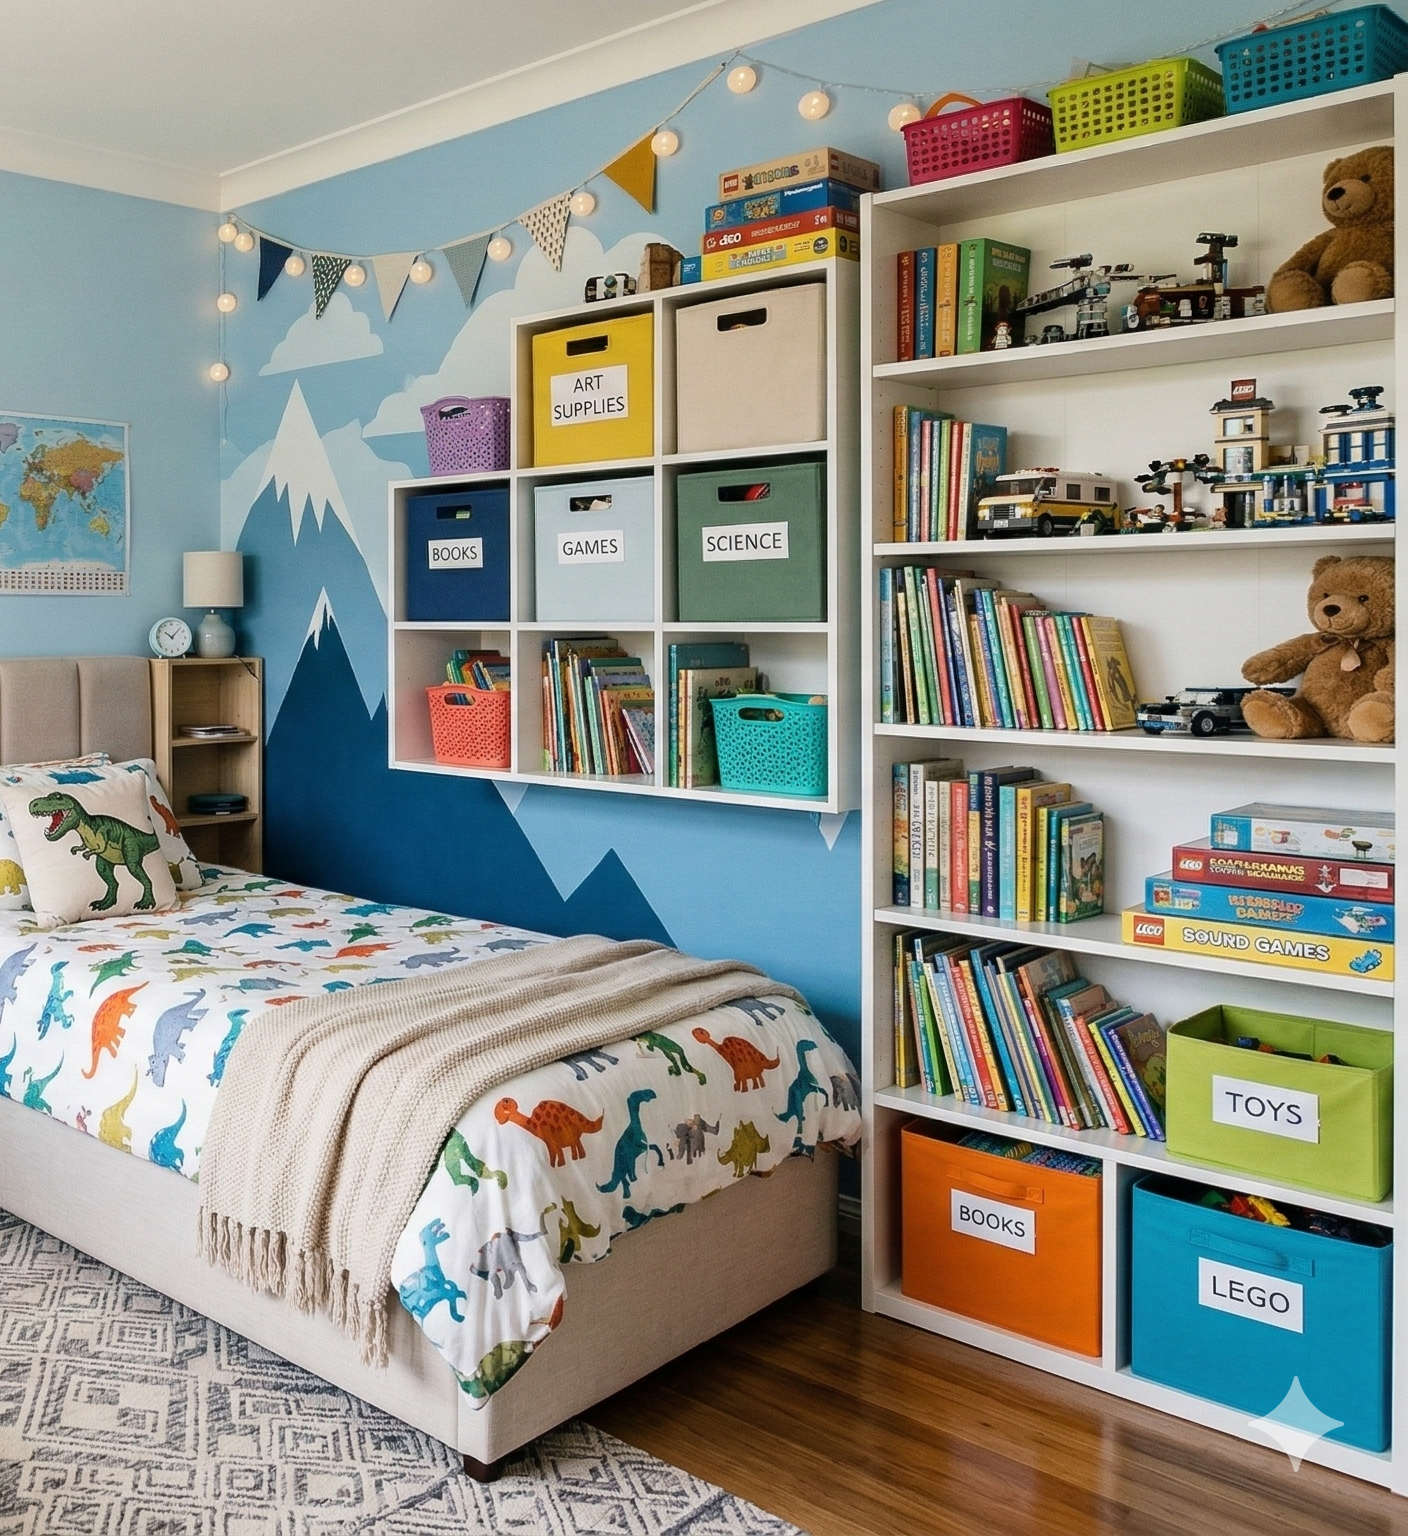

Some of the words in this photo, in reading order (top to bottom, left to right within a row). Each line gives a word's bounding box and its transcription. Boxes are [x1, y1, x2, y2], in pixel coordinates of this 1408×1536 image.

[573, 374, 604, 394] ART
[553, 395, 625, 420] SUPPLIES
[431, 545, 478, 562] BOOKS
[562, 538, 619, 556] GAMES
[706, 532, 783, 552] SCIENCE
[1254, 936, 1331, 962] GAMES
[1225, 1091, 1302, 1125] TOYS
[959, 1204, 1026, 1238] BOOKS
[1212, 1275, 1290, 1314] LEGO
